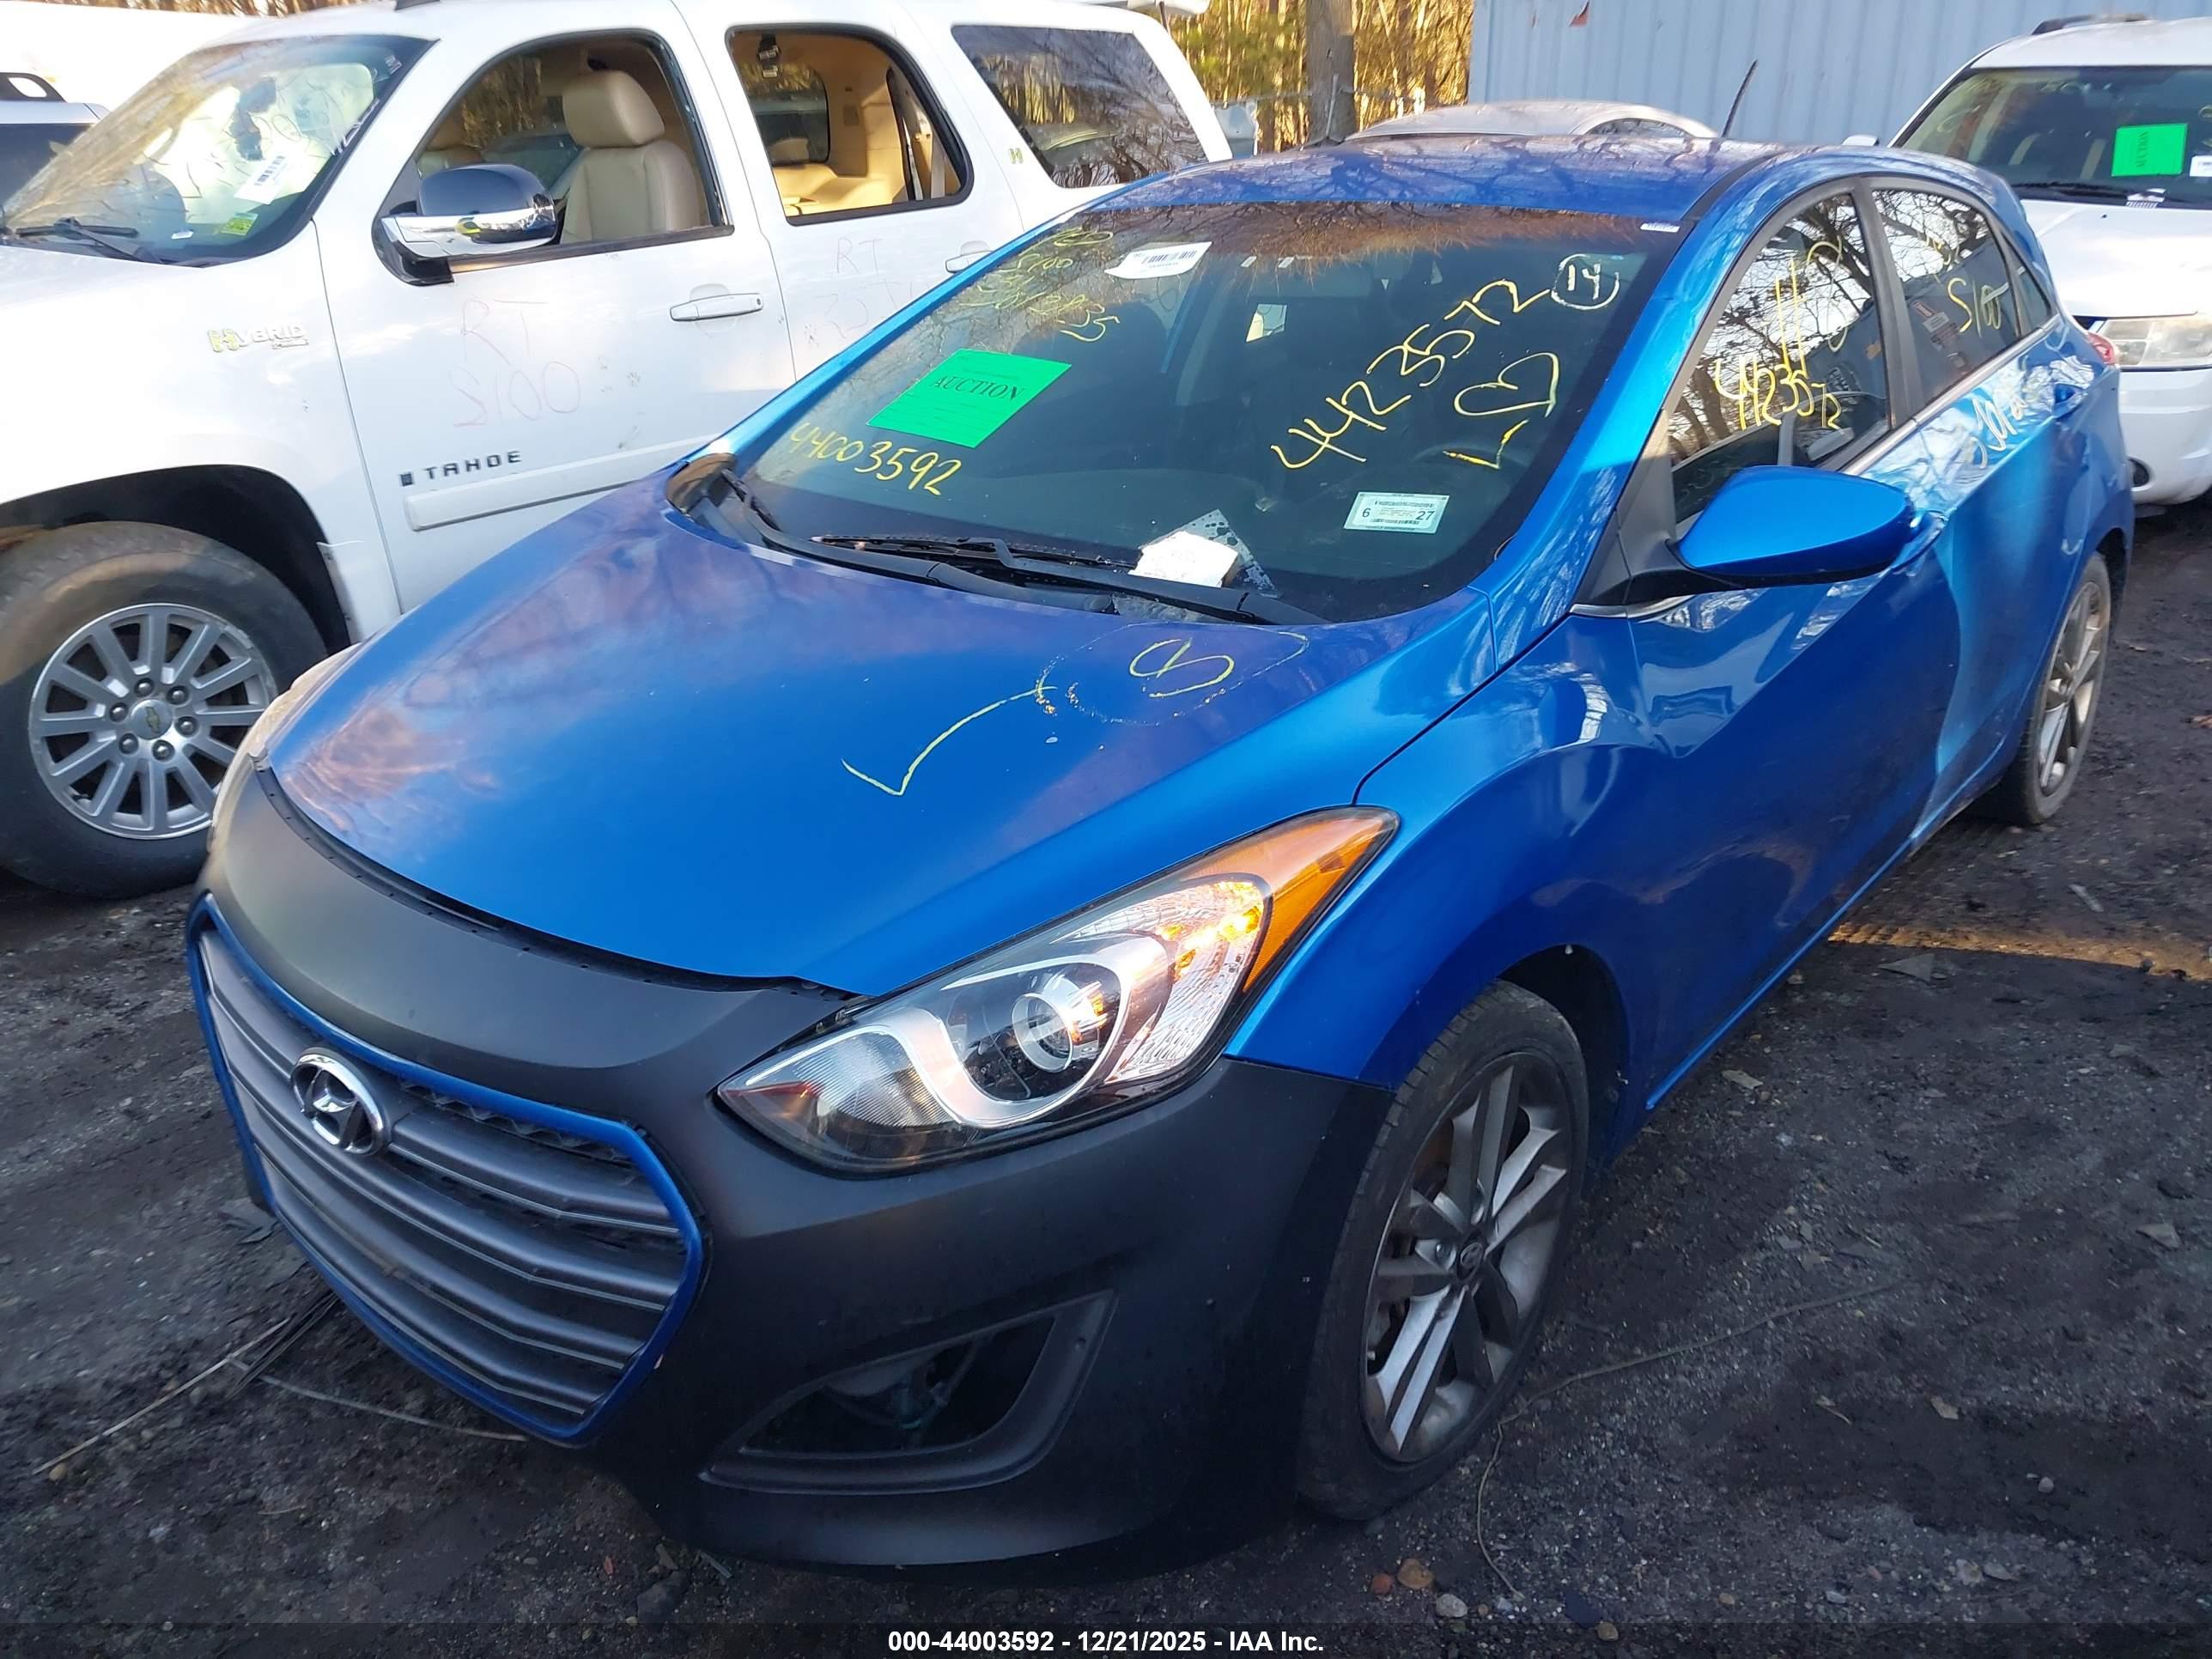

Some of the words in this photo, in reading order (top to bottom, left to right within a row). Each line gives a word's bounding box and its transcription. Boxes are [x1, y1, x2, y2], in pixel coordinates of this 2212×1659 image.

[1567, 264, 1601, 300] 14
[930, 374, 1026, 401] AUCTION
[1270, 278, 1551, 468] 4423572
[425, 450, 523, 480] TAHOE
[789, 422, 962, 495] 44003592
[1363, 507, 1371, 518] 6
[1416, 510, 1436, 520] 27
